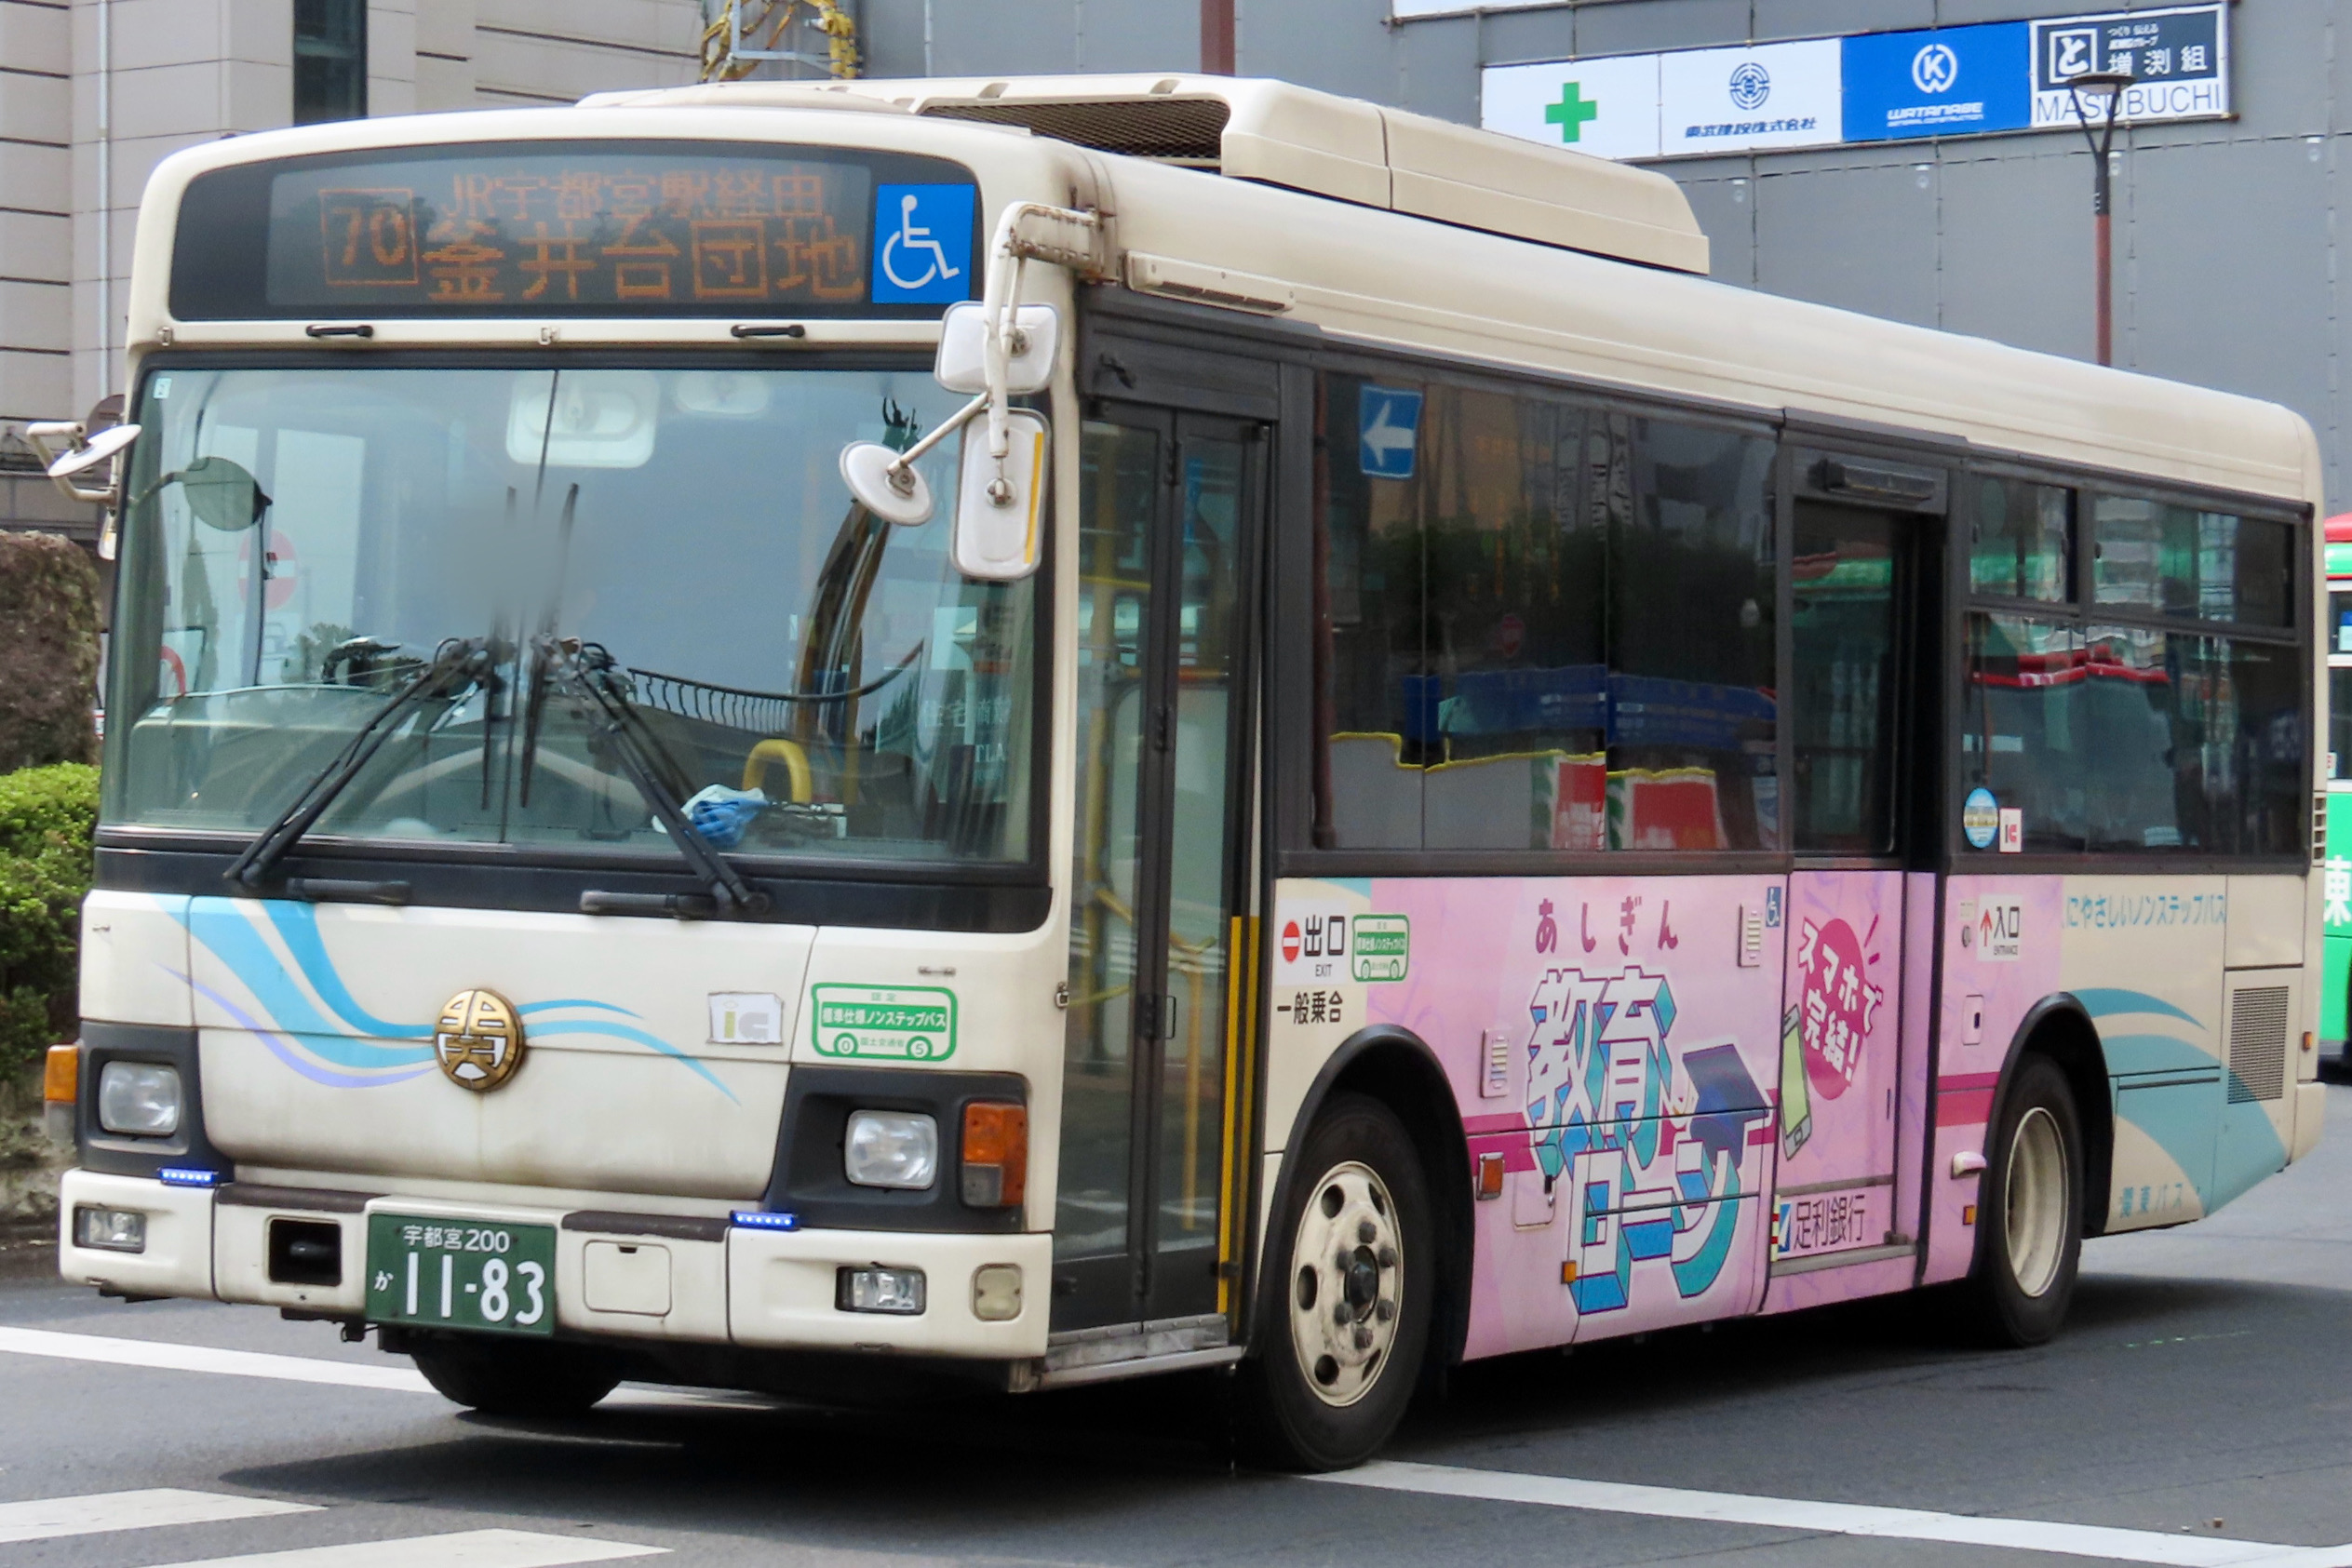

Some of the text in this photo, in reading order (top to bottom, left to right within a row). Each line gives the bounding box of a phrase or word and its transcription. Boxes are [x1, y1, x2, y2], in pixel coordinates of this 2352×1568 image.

[1887, 101, 1983, 120] WATANABE
[2036, 84, 2220, 122] MASUBUCHI
[439, 168, 824, 221] JR宇都宮駅経由
[331, 206, 408, 266] 70
[1536, 896, 1678, 956] あしぎん
[1994, 906, 2020, 939] 入口
[2063, 894, 2226, 929] にやさしいノンステップバス
[1304, 915, 1346, 957] 出口
[1315, 964, 1333, 977] EXIT
[1797, 919, 1884, 1038] スマホで
[822, 1007, 947, 1027] 標準仕様ノンステップバス
[1276, 990, 1343, 1024] 一般乗合
[1527, 965, 1676, 1163] 教育
[1567, 1141, 1740, 1314] ローン
[1794, 1194, 1866, 1250] 足利銀行
[373, 1252, 545, 1325] か 11-83
